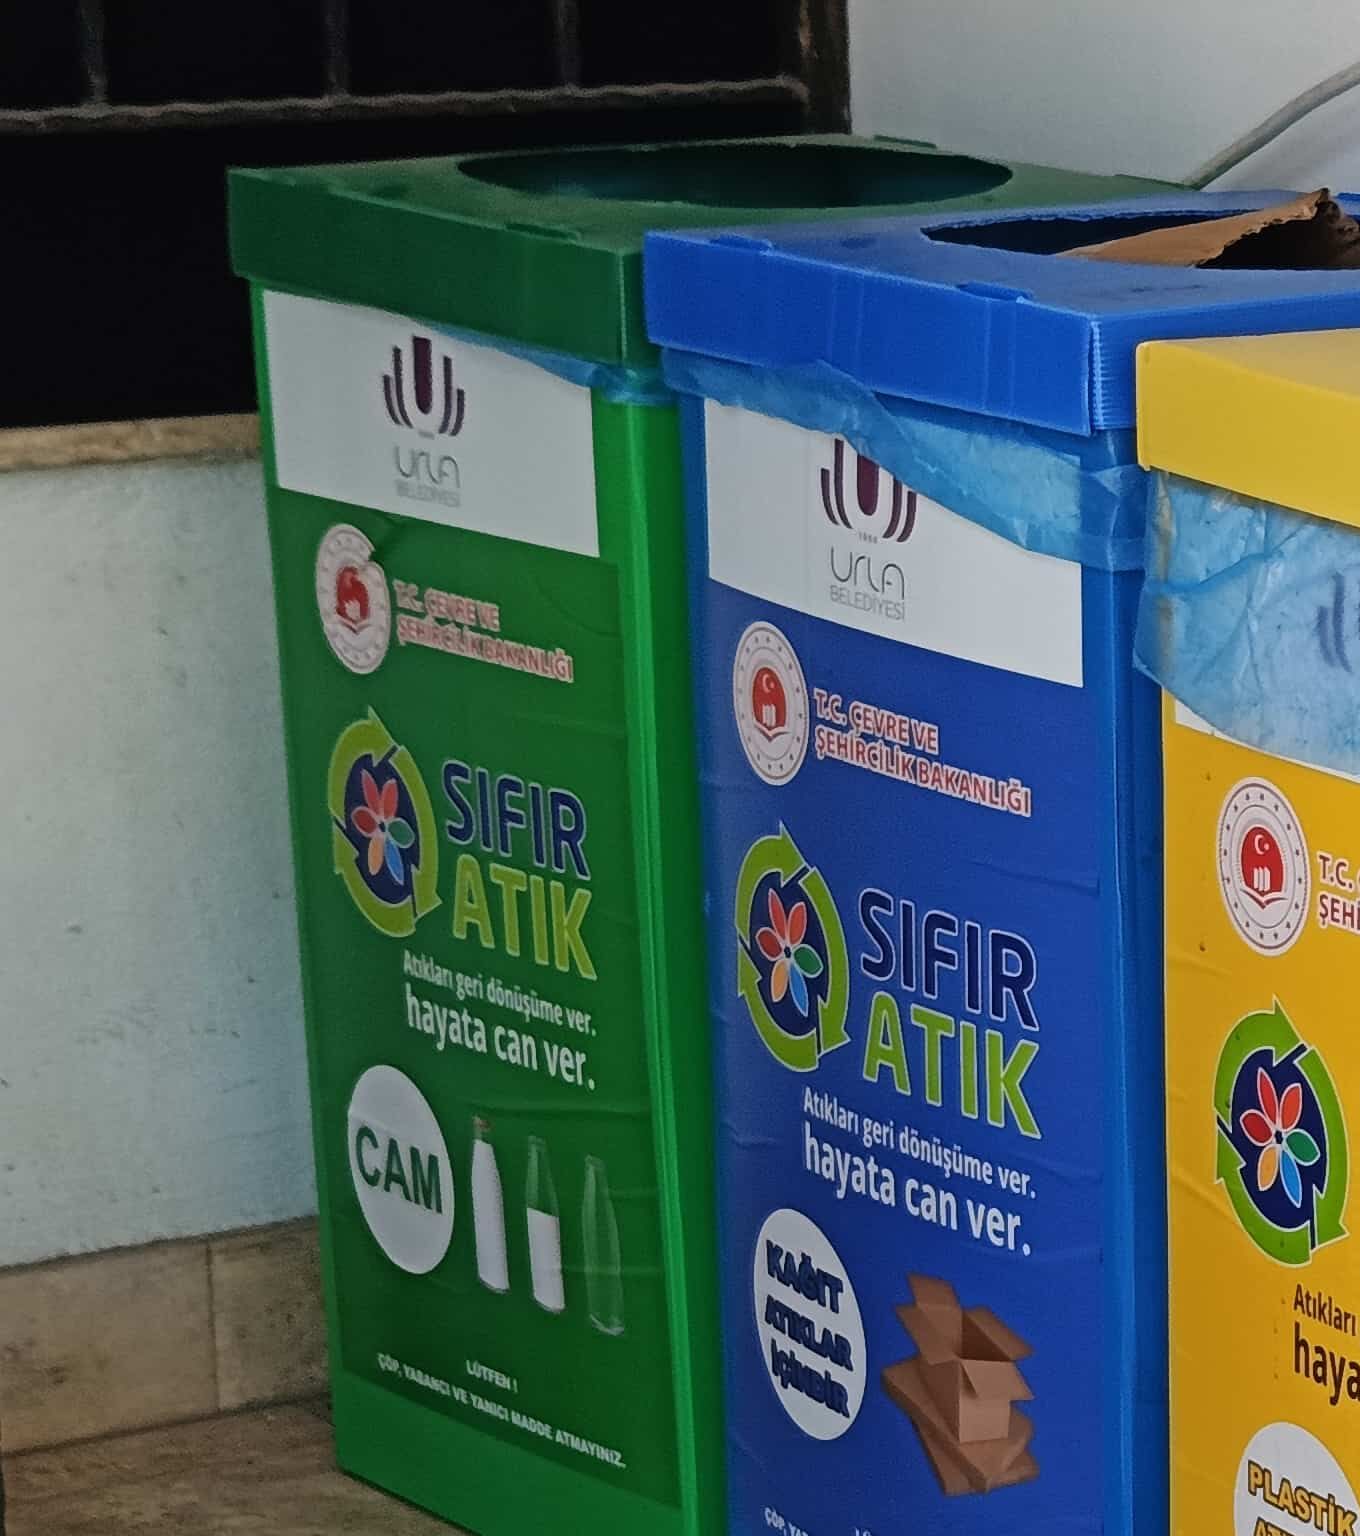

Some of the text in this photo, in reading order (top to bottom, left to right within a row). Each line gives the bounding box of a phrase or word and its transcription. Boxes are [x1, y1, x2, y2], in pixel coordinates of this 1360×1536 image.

[483, 636, 573, 682] BAKANLIĞI
[814, 690, 938, 754] T.C. ÇEVRE VE
[815, 727, 1031, 817] ŞEHİRCİLİK BAKANLIĞI
[442, 760, 591, 880] SIFIR
[1318, 854, 1353, 891] T.C.
[453, 854, 597, 981] ATIK
[858, 887, 1040, 1031] SIFIR
[403, 950, 597, 1036] Atıkları geri dönüşüme ver.
[405, 982, 596, 1091] hayata can ver.
[862, 991, 1041, 1139] ATIK
[355, 1126, 442, 1213] CAM
[804, 1087, 1036, 1199] Atıkları geri dönüşüme ver.
[804, 1123, 1031, 1257] hayata can ver.
[765, 1239, 843, 1314] KAĞIT
[1294, 1284, 1355, 1337] Atıkları
[466, 1359, 511, 1389] LÜTFEN
[765, 1294, 853, 1371] ATIKLAR
[771, 1339, 849, 1418] İÇİNDİR
[453, 1386, 467, 1404] VE
[469, 1394, 509, 1422] YANICI
[511, 1412, 552, 1440] MADDE
[555, 1430, 626, 1468] ATMAYINIZ.
[764, 1506, 787, 1536] ÇÖP,
